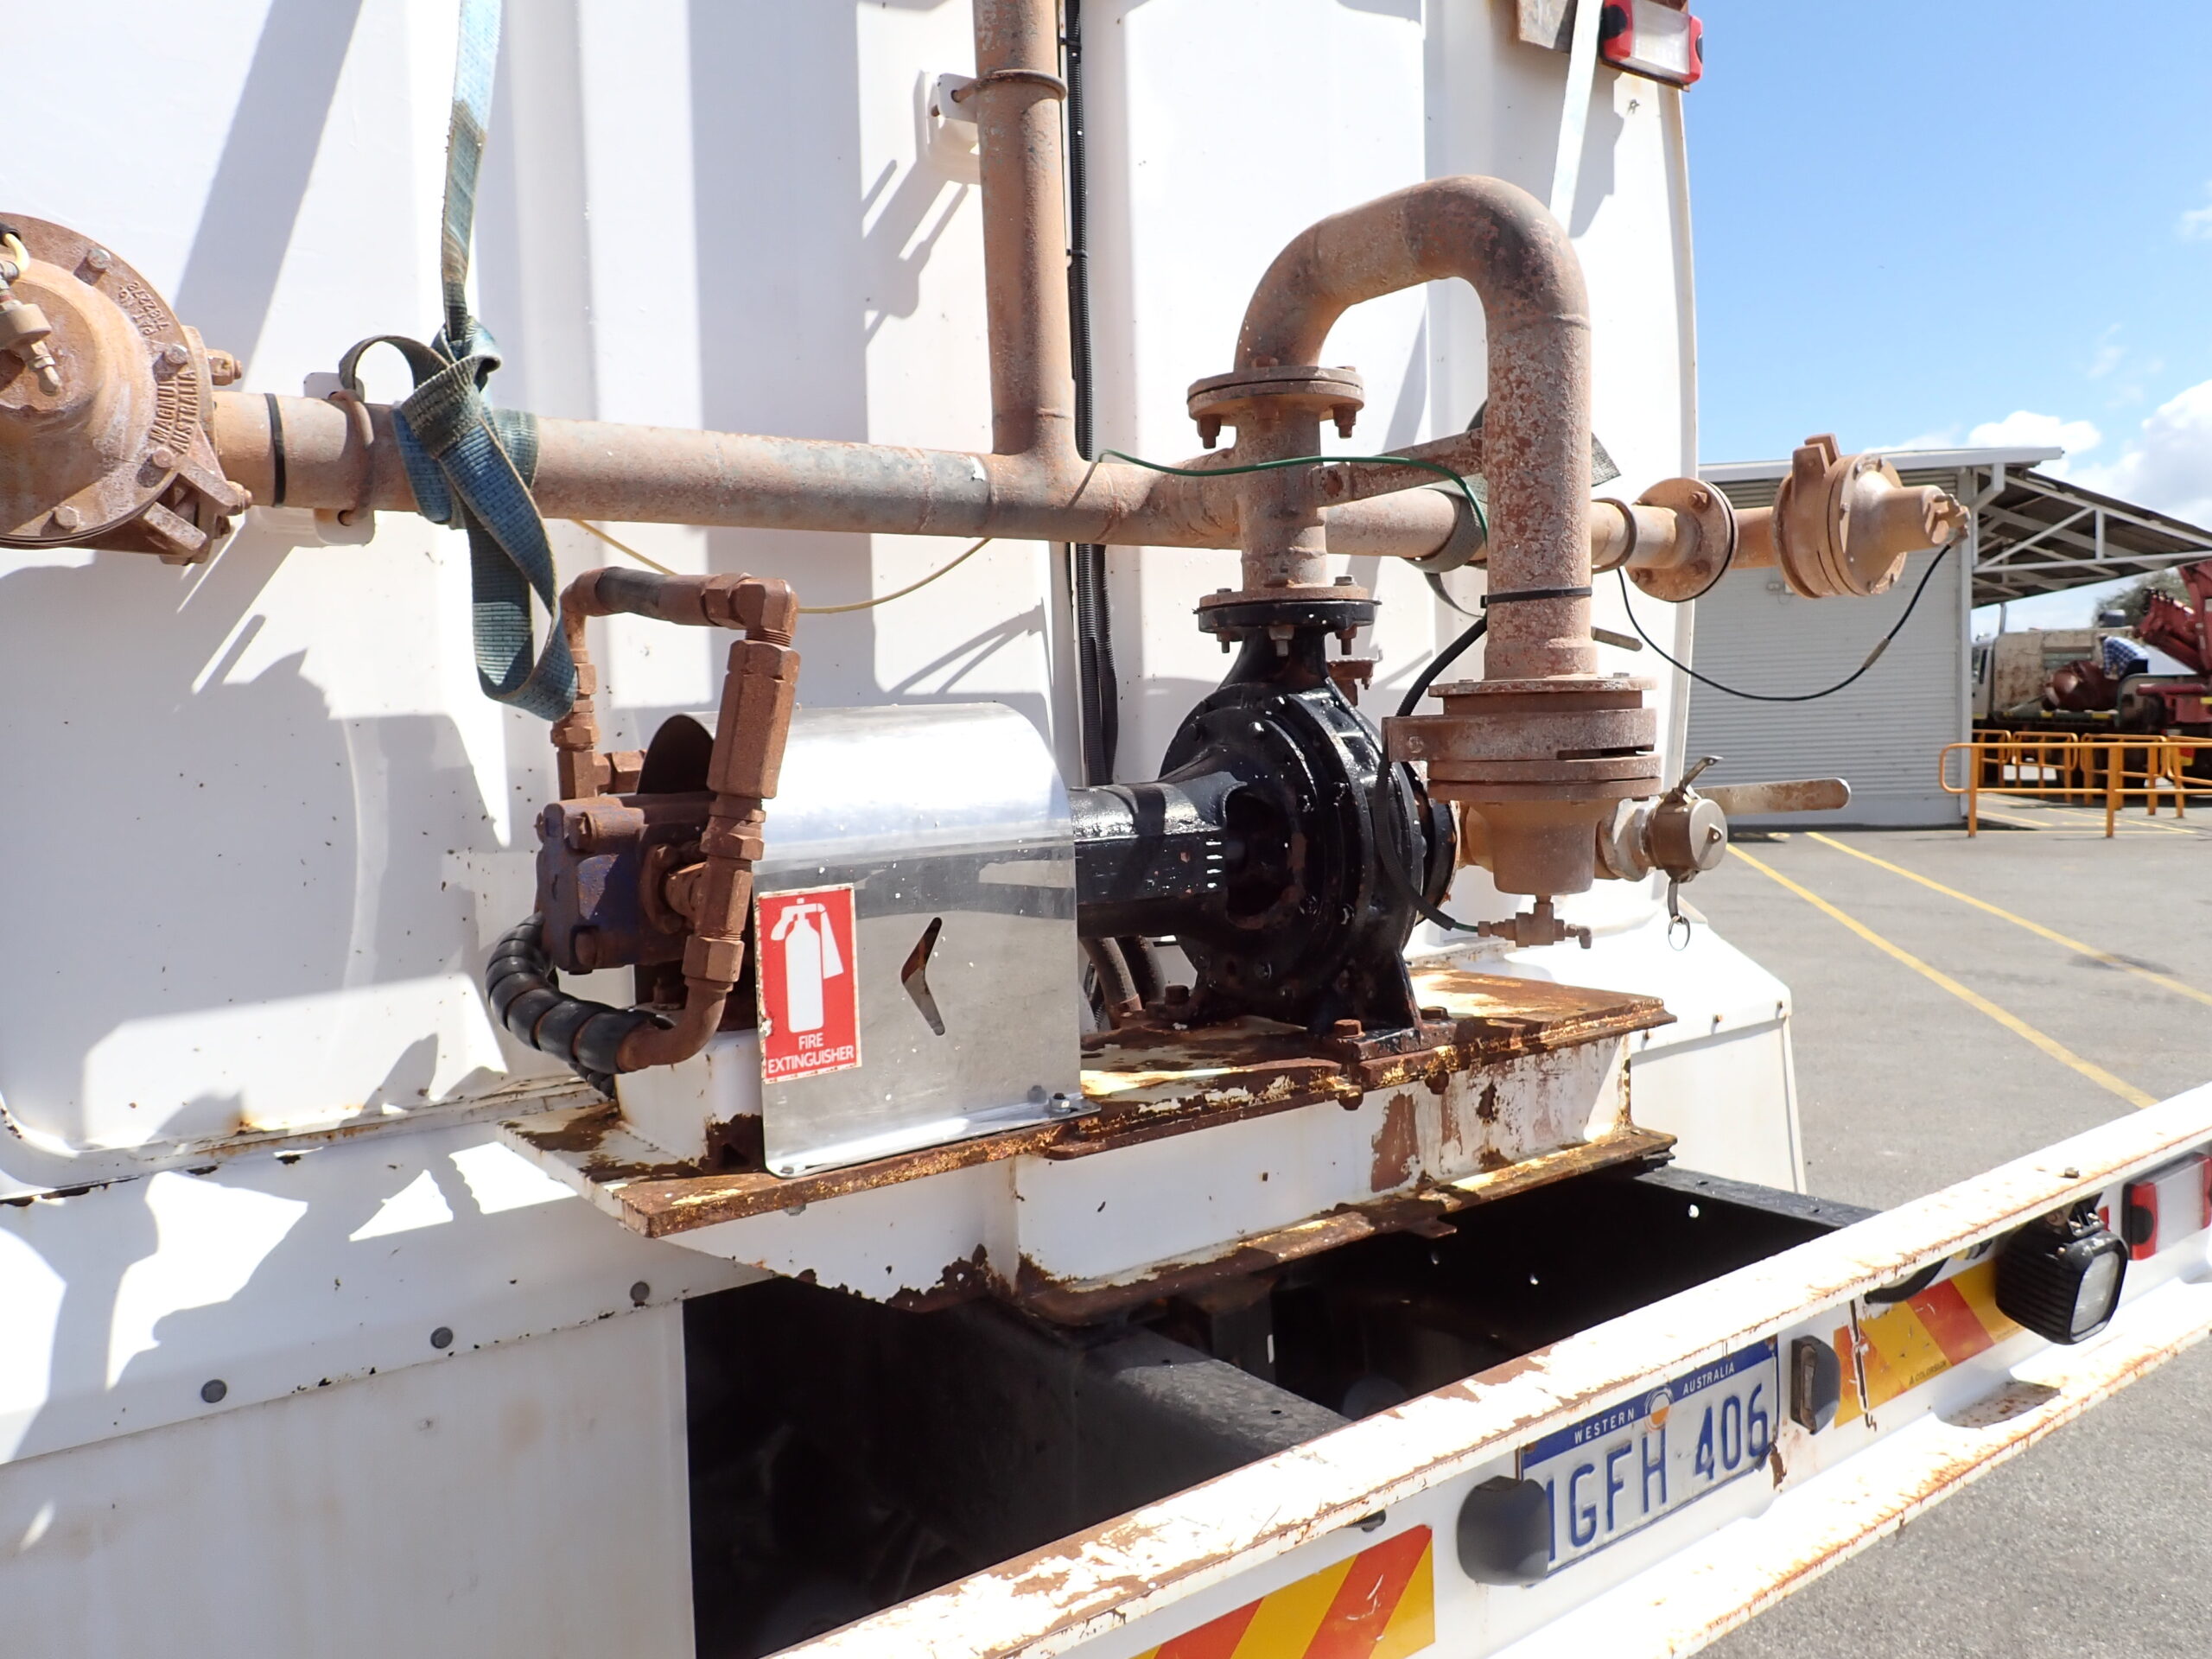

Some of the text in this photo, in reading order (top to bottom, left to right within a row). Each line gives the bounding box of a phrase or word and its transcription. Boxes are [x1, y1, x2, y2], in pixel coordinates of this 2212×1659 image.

[169, 370, 199, 454] AUSTRALIA
[767, 1045, 855, 1074] EXTINGUISHER
[798, 1033, 824, 1051] FIRE
[1574, 1362, 1736, 1446] WESTERN AUSTRALIA
[1694, 1382, 1768, 1481] 406
